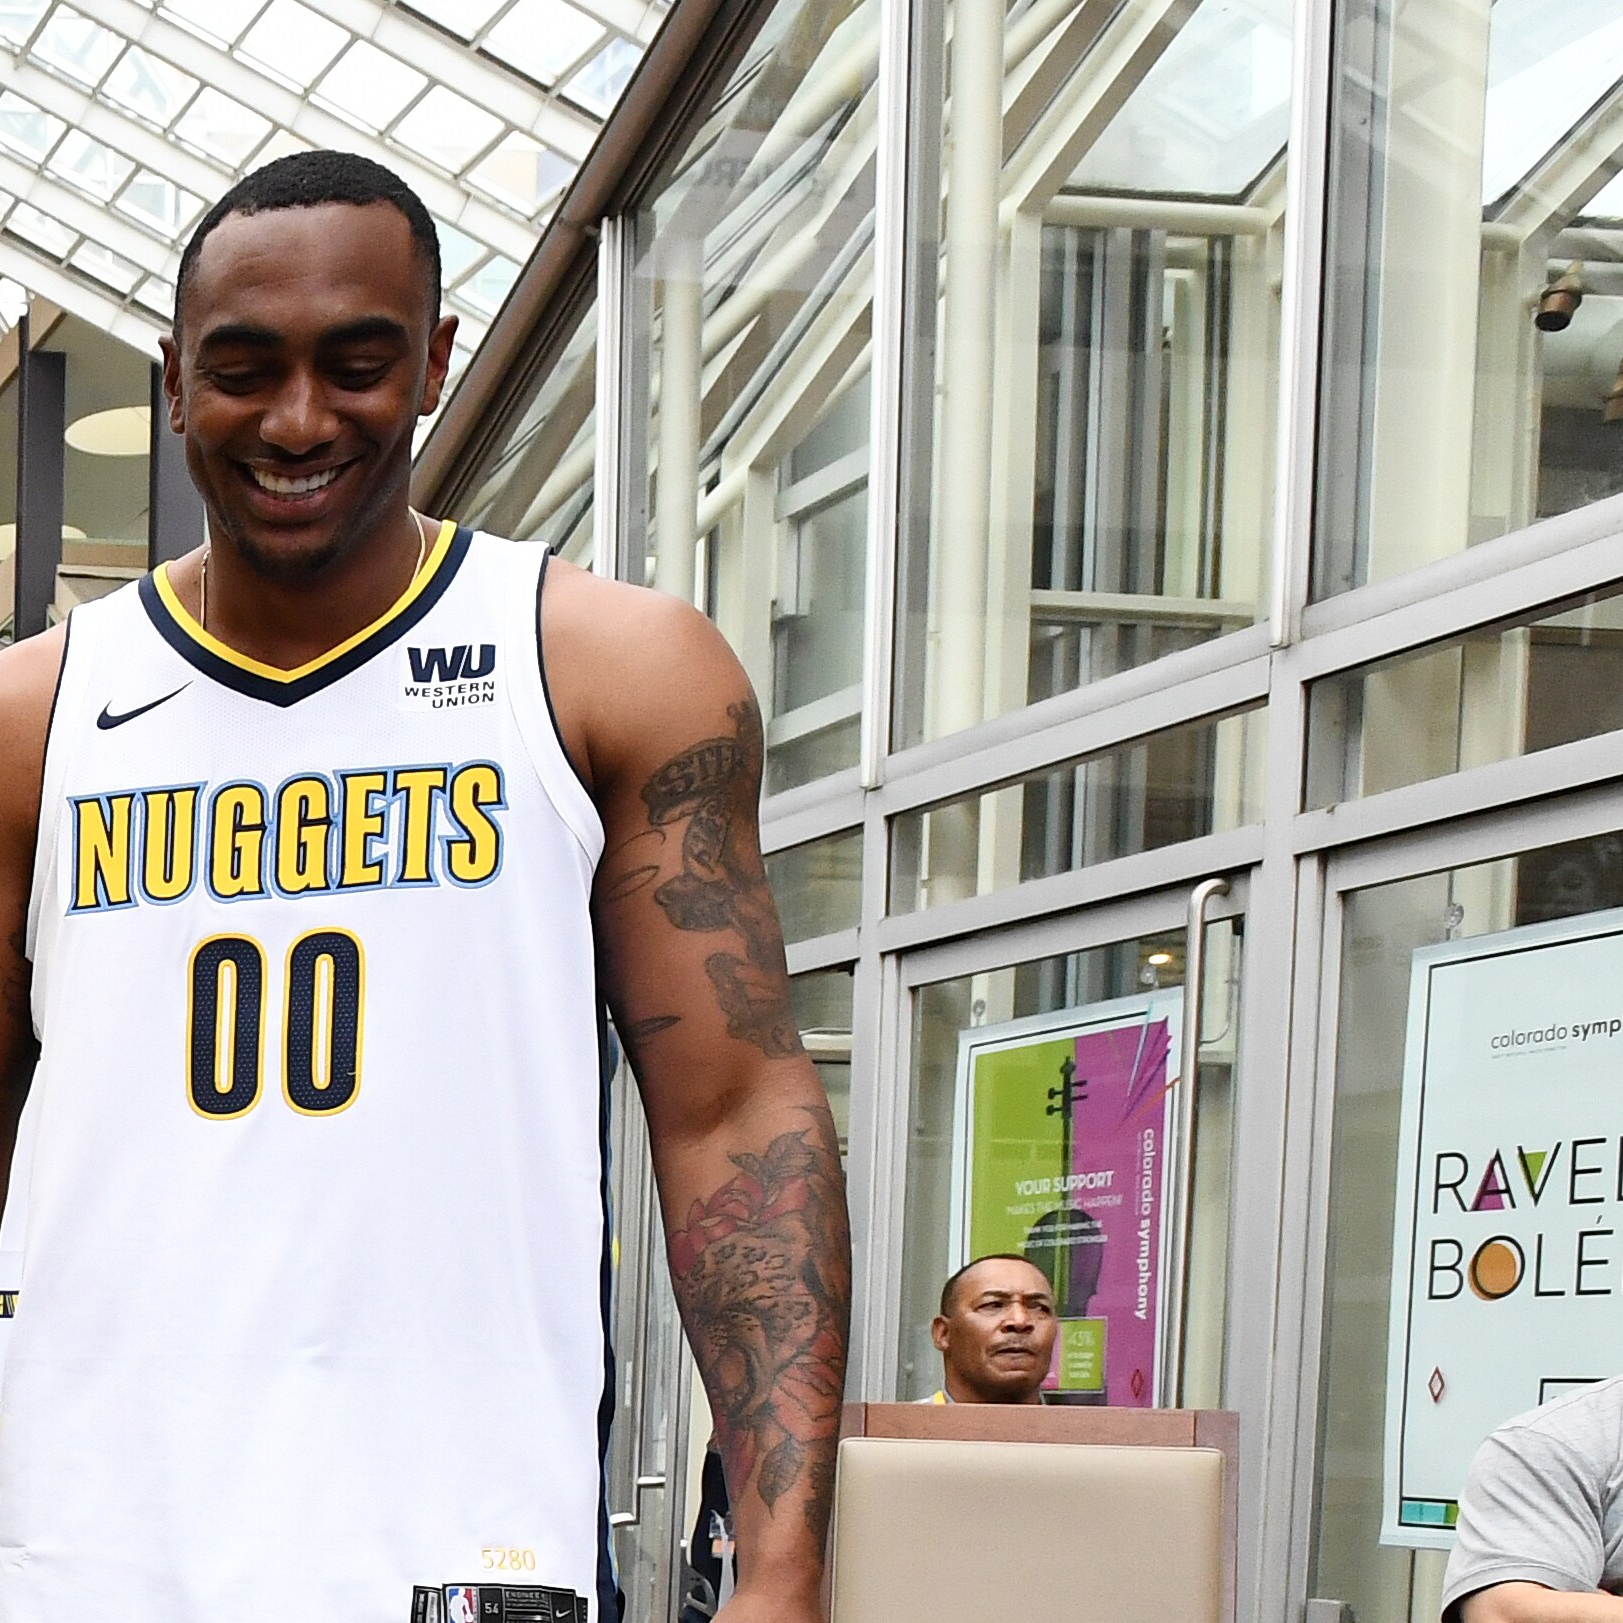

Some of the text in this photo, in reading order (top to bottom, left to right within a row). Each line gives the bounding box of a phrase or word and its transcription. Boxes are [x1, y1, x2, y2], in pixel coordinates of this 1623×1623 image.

[407, 644, 496, 683] WU
[404, 681, 495, 697] WESTERN
[432, 692, 494, 708] UNION
[66, 757, 509, 916] NUGGETS
[185, 925, 366, 1121] 00
[1491, 1018, 1622, 1049] colorado symp
[1015, 1170, 1114, 1195] YOUR SUPPORT
[1140, 1128, 1156, 1214] colorado
[1433, 1136, 1623, 1214] RAVE
[1134, 1218, 1153, 1321] symphony
[1428, 1215, 1614, 1301] BOLÉ
[481, 1547, 536, 1571] 5280
[484, 1602, 499, 1614] 54
